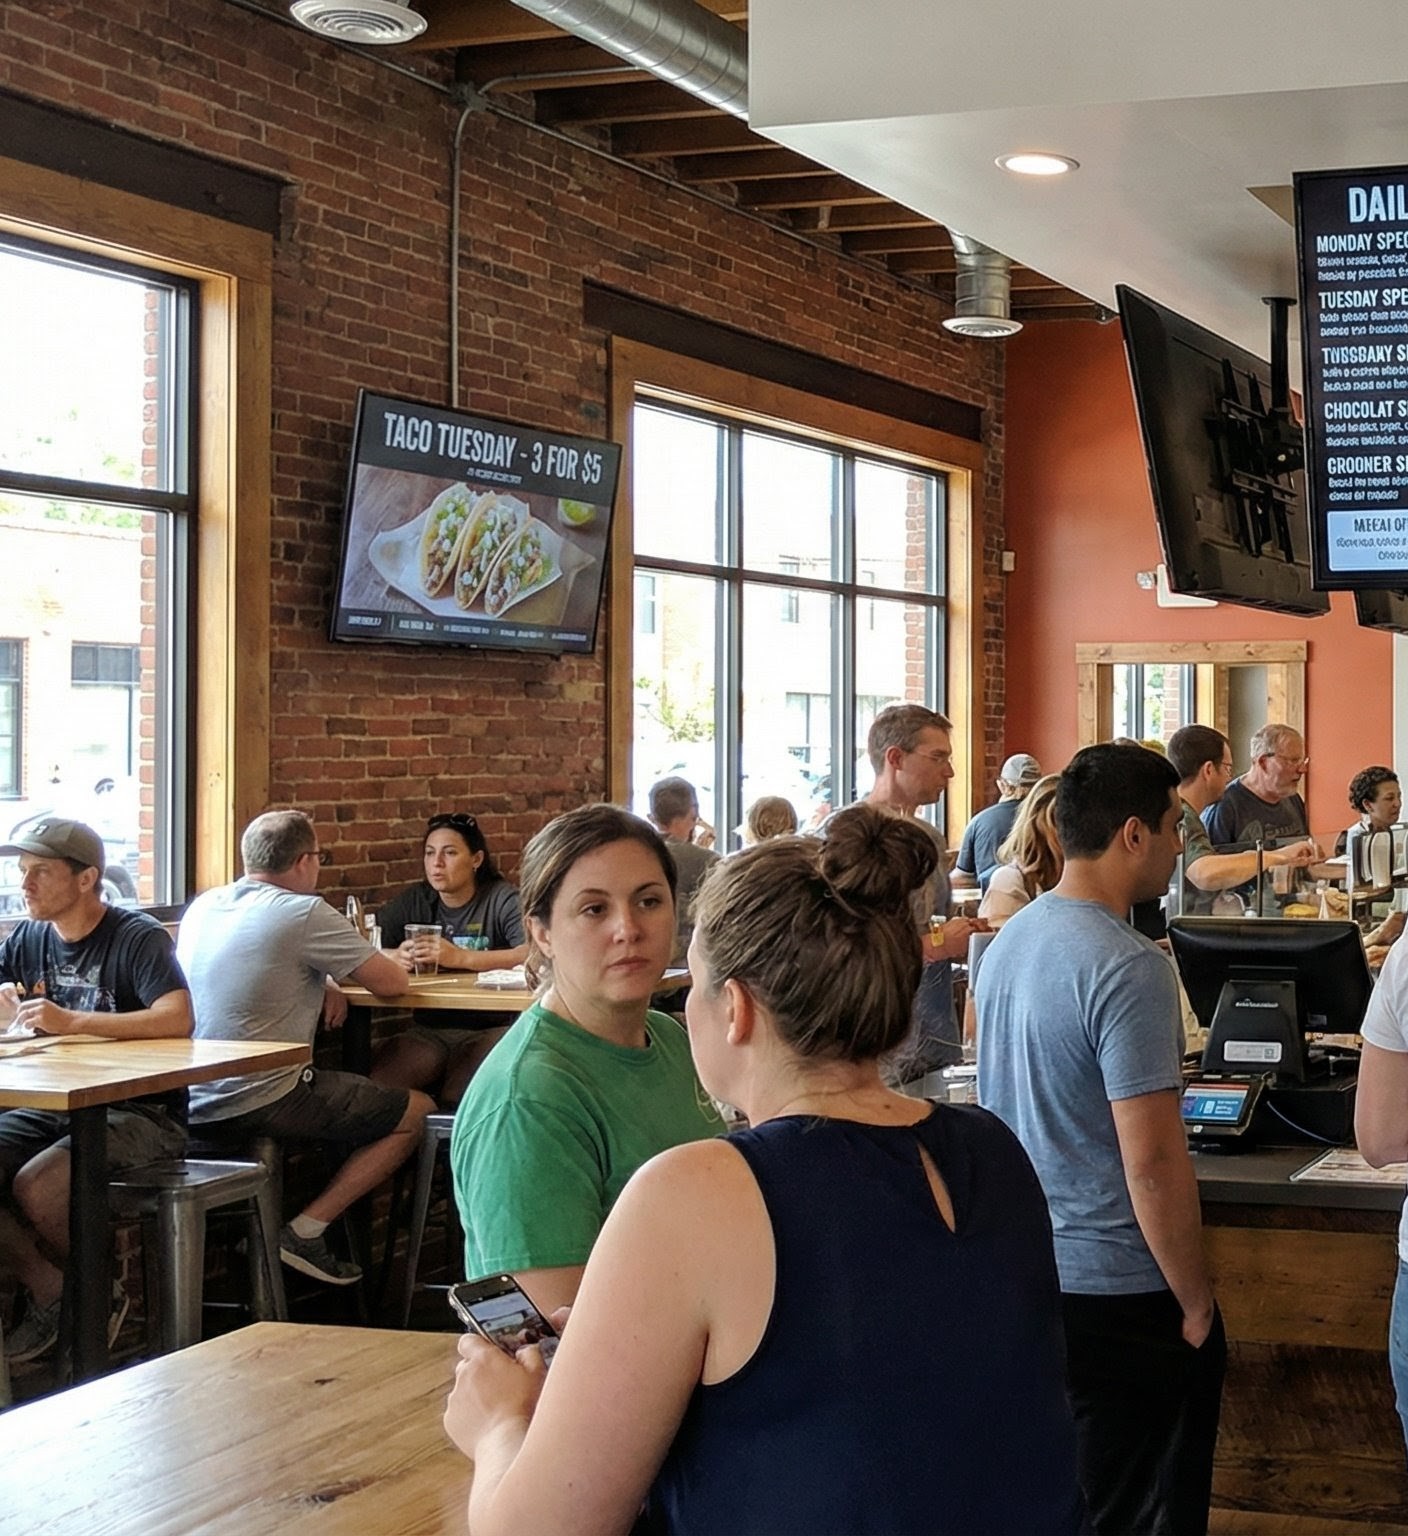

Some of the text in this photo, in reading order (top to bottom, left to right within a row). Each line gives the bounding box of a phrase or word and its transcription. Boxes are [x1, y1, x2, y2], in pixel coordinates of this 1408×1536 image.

[1316, 233, 1373, 253] MONDAY
[1318, 289, 1379, 310] TUESDAY
[1324, 400, 1394, 420] CHOCOLAT
[384, 411, 433, 453] TACO
[437, 423, 518, 469] TUESDAY
[531, 442, 542, 474] 3
[545, 445, 579, 481] FOR
[582, 451, 602, 485] $5
